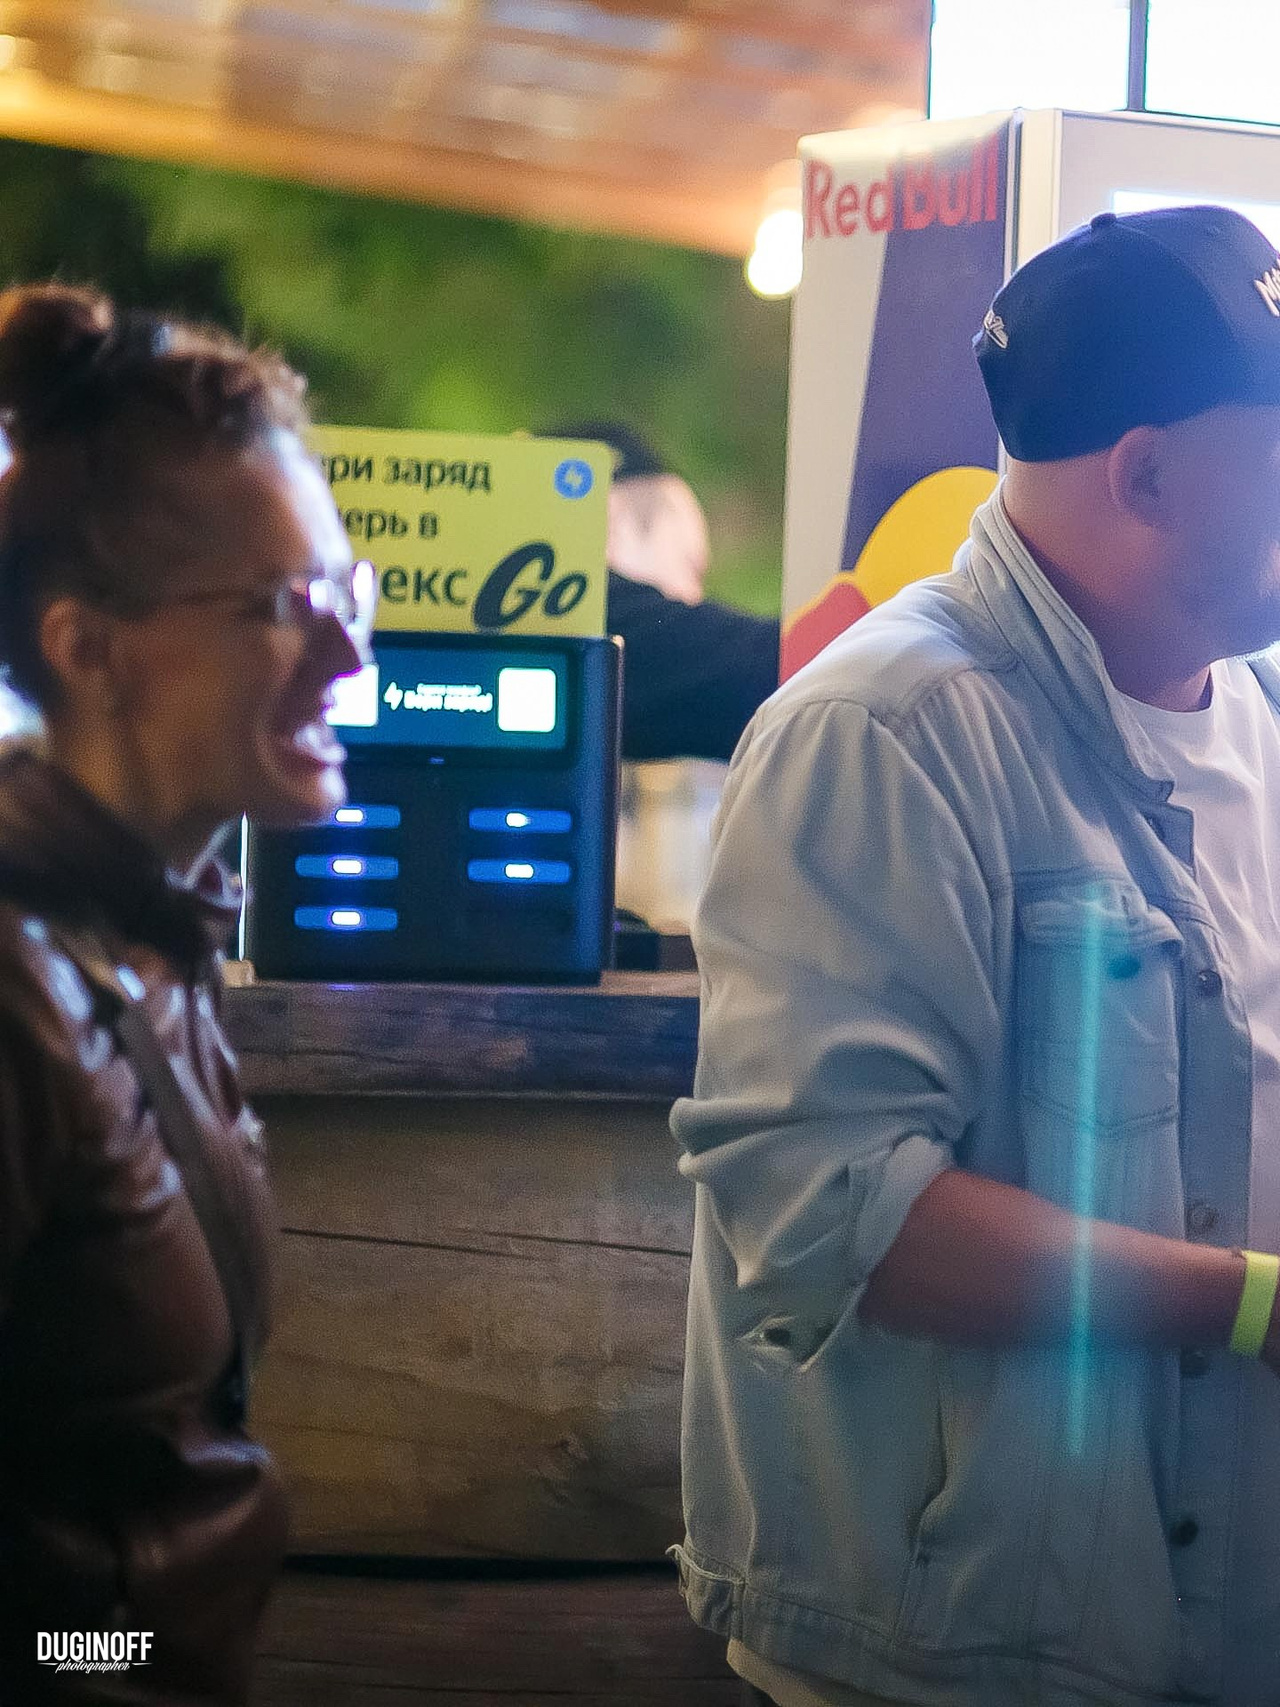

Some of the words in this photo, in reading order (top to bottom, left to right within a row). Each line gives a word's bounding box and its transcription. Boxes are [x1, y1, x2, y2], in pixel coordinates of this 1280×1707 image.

[805, 158, 893, 238] Red
[902, 132, 998, 230] Bull
[322, 455, 373, 487] ри
[384, 456, 491, 491] заряд
[338, 509, 408, 541] ерь
[419, 511, 439, 538] в
[381, 565, 468, 606] екс
[473, 541, 588, 628] Go
